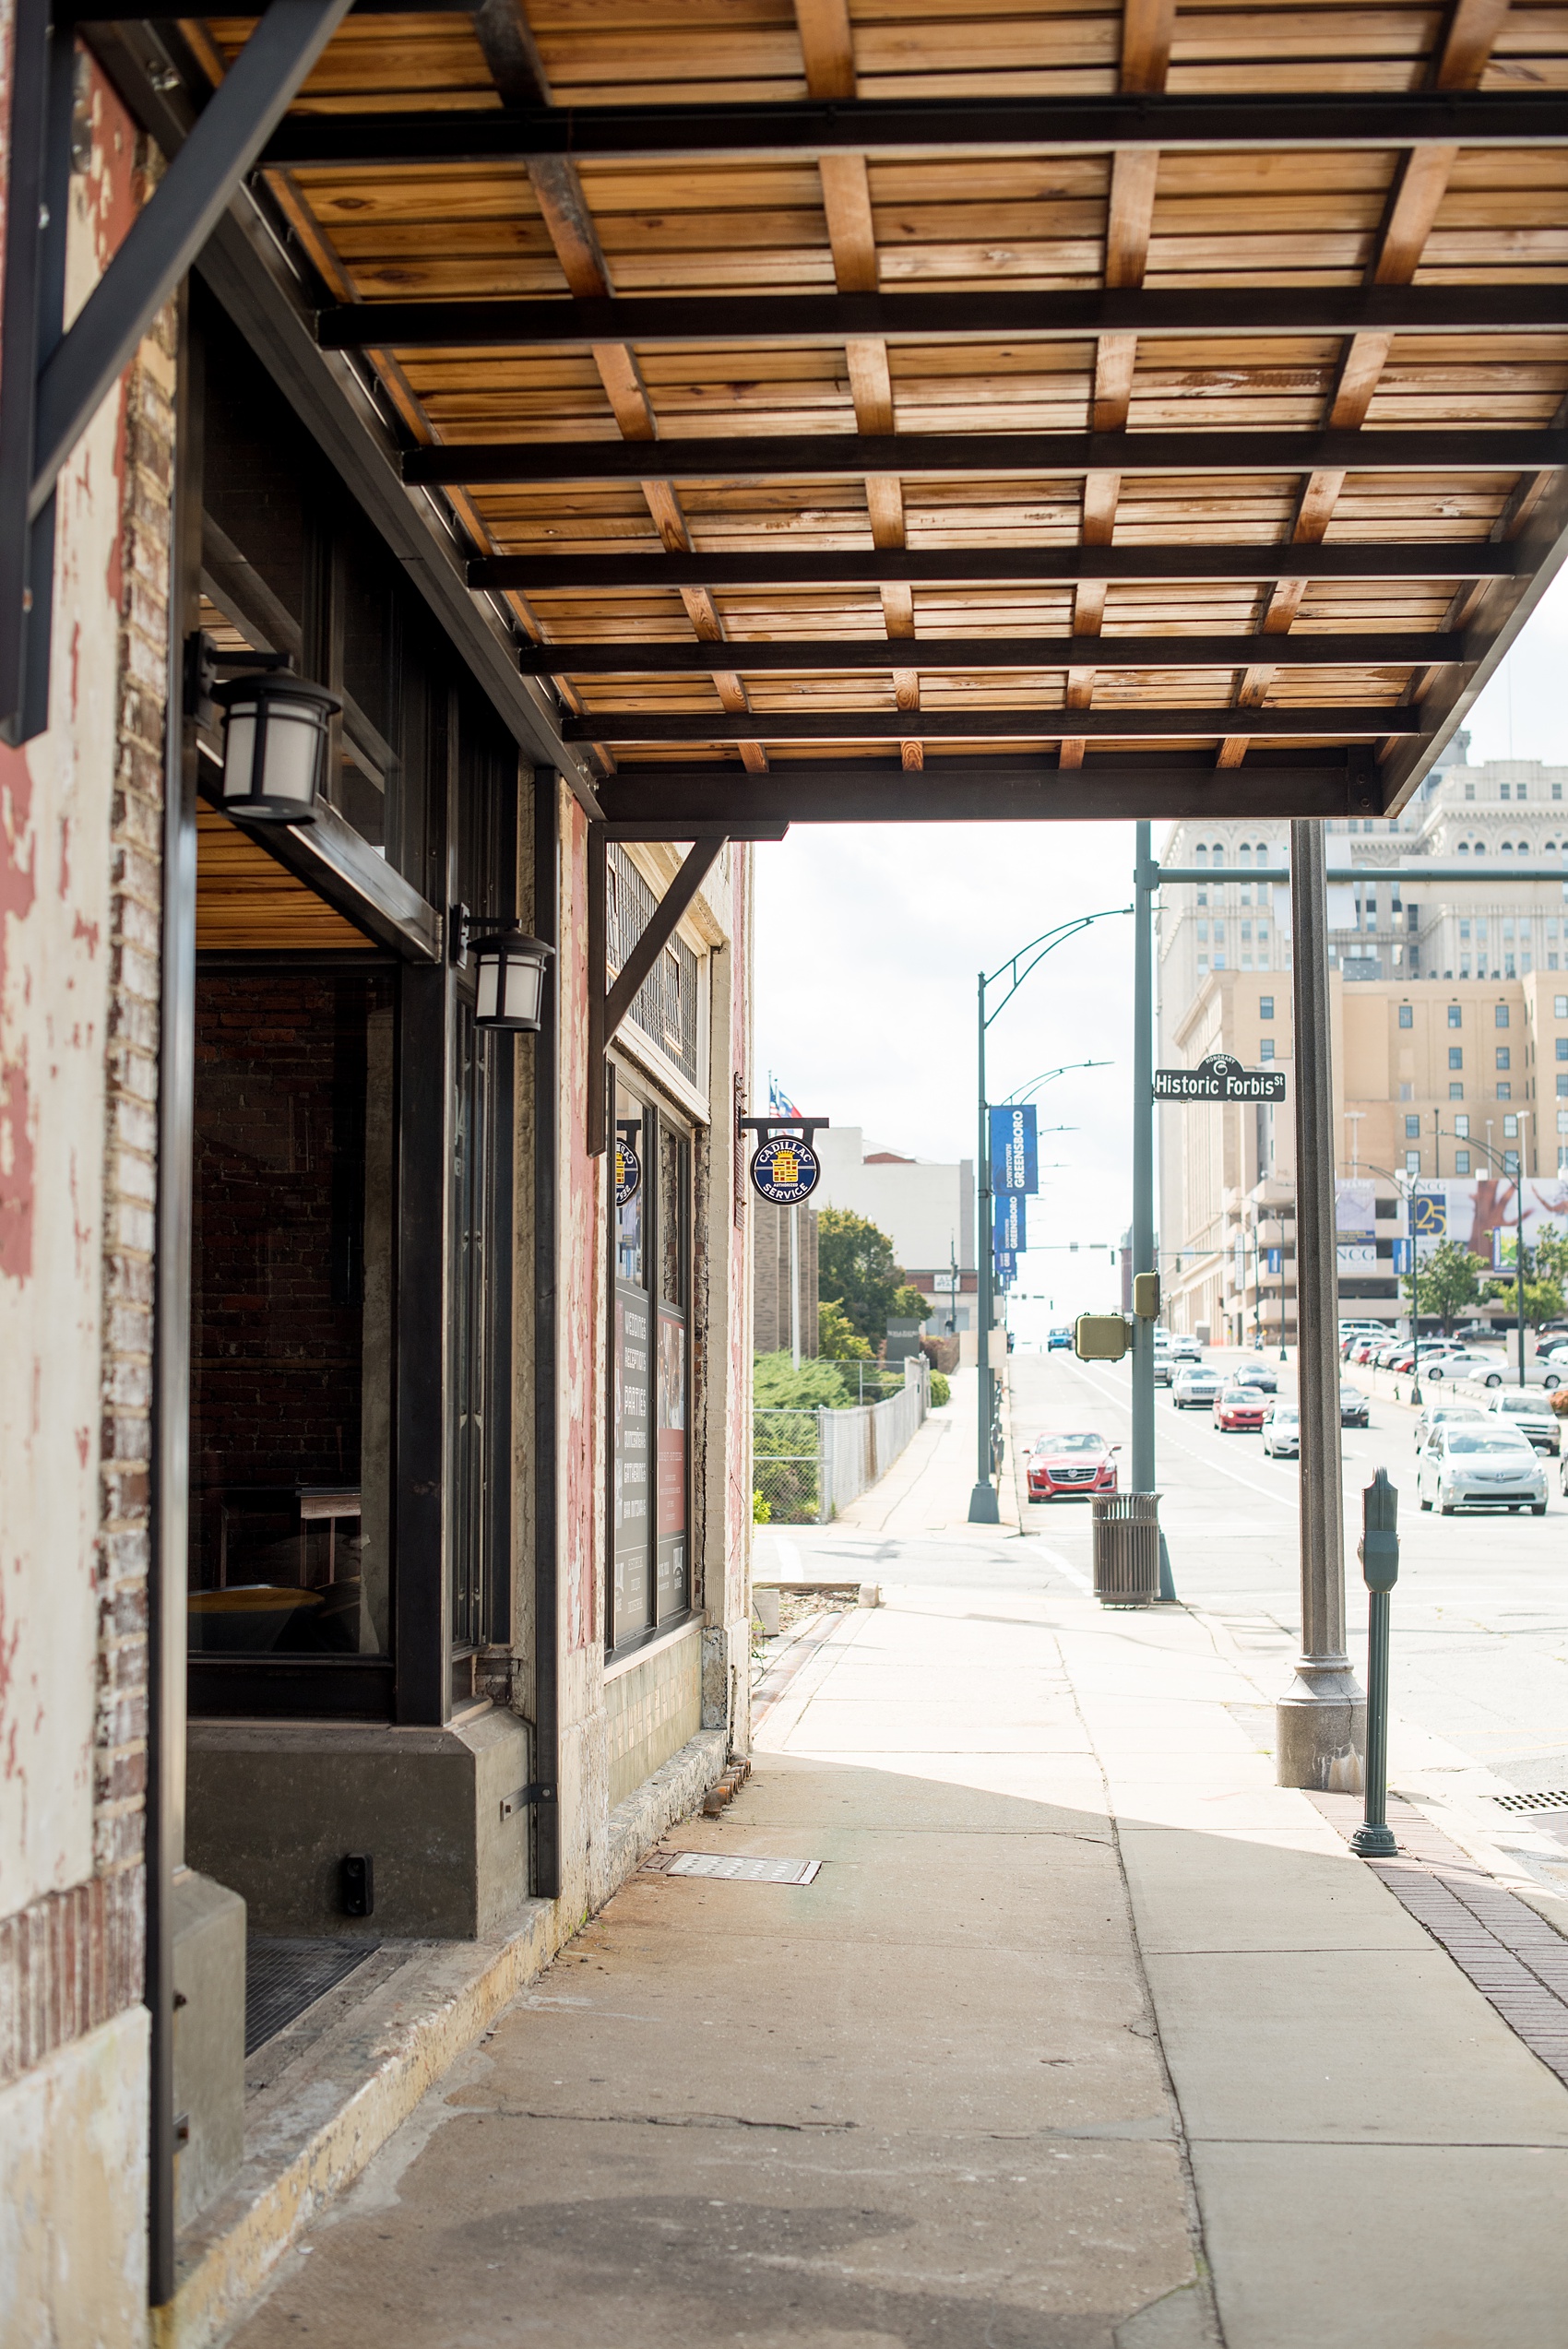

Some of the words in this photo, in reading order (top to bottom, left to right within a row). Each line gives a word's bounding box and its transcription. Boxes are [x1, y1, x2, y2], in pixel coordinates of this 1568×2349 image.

[1206, 1055, 1236, 1065] HONORARY
[1156, 1074, 1219, 1095] Historic
[1226, 1075, 1275, 1096] Forbis
[1274, 1075, 1284, 1086] St
[759, 1142, 812, 1163] CADILLAC
[1013, 1110, 1025, 1188] GREENSBORO
[763, 1182, 808, 1199] SERVICE
[1009, 1196, 1018, 1249] GREENSBORO
[1408, 1194, 1447, 1237] 125
[624, 1385, 647, 1417] PARTIES
